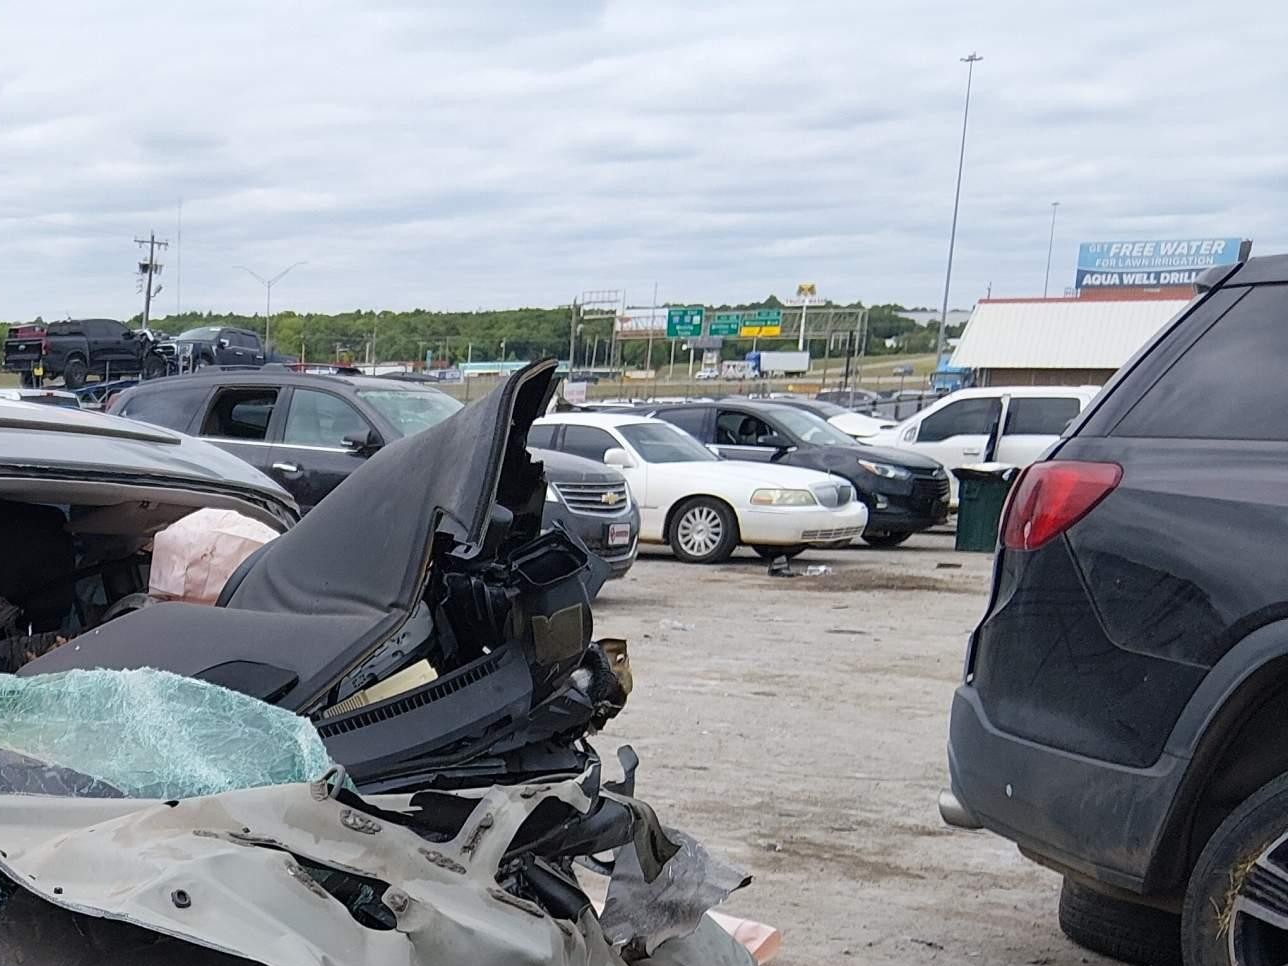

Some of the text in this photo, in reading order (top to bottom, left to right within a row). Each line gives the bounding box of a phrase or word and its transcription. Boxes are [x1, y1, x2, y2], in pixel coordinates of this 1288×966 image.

[1089, 240, 1225, 256] GET FREE WATER
[1096, 255, 1214, 267] FOR LAWN IRRIGATION
[1082, 273, 1120, 285] AQUA
[1122, 273, 1157, 285] WELL
